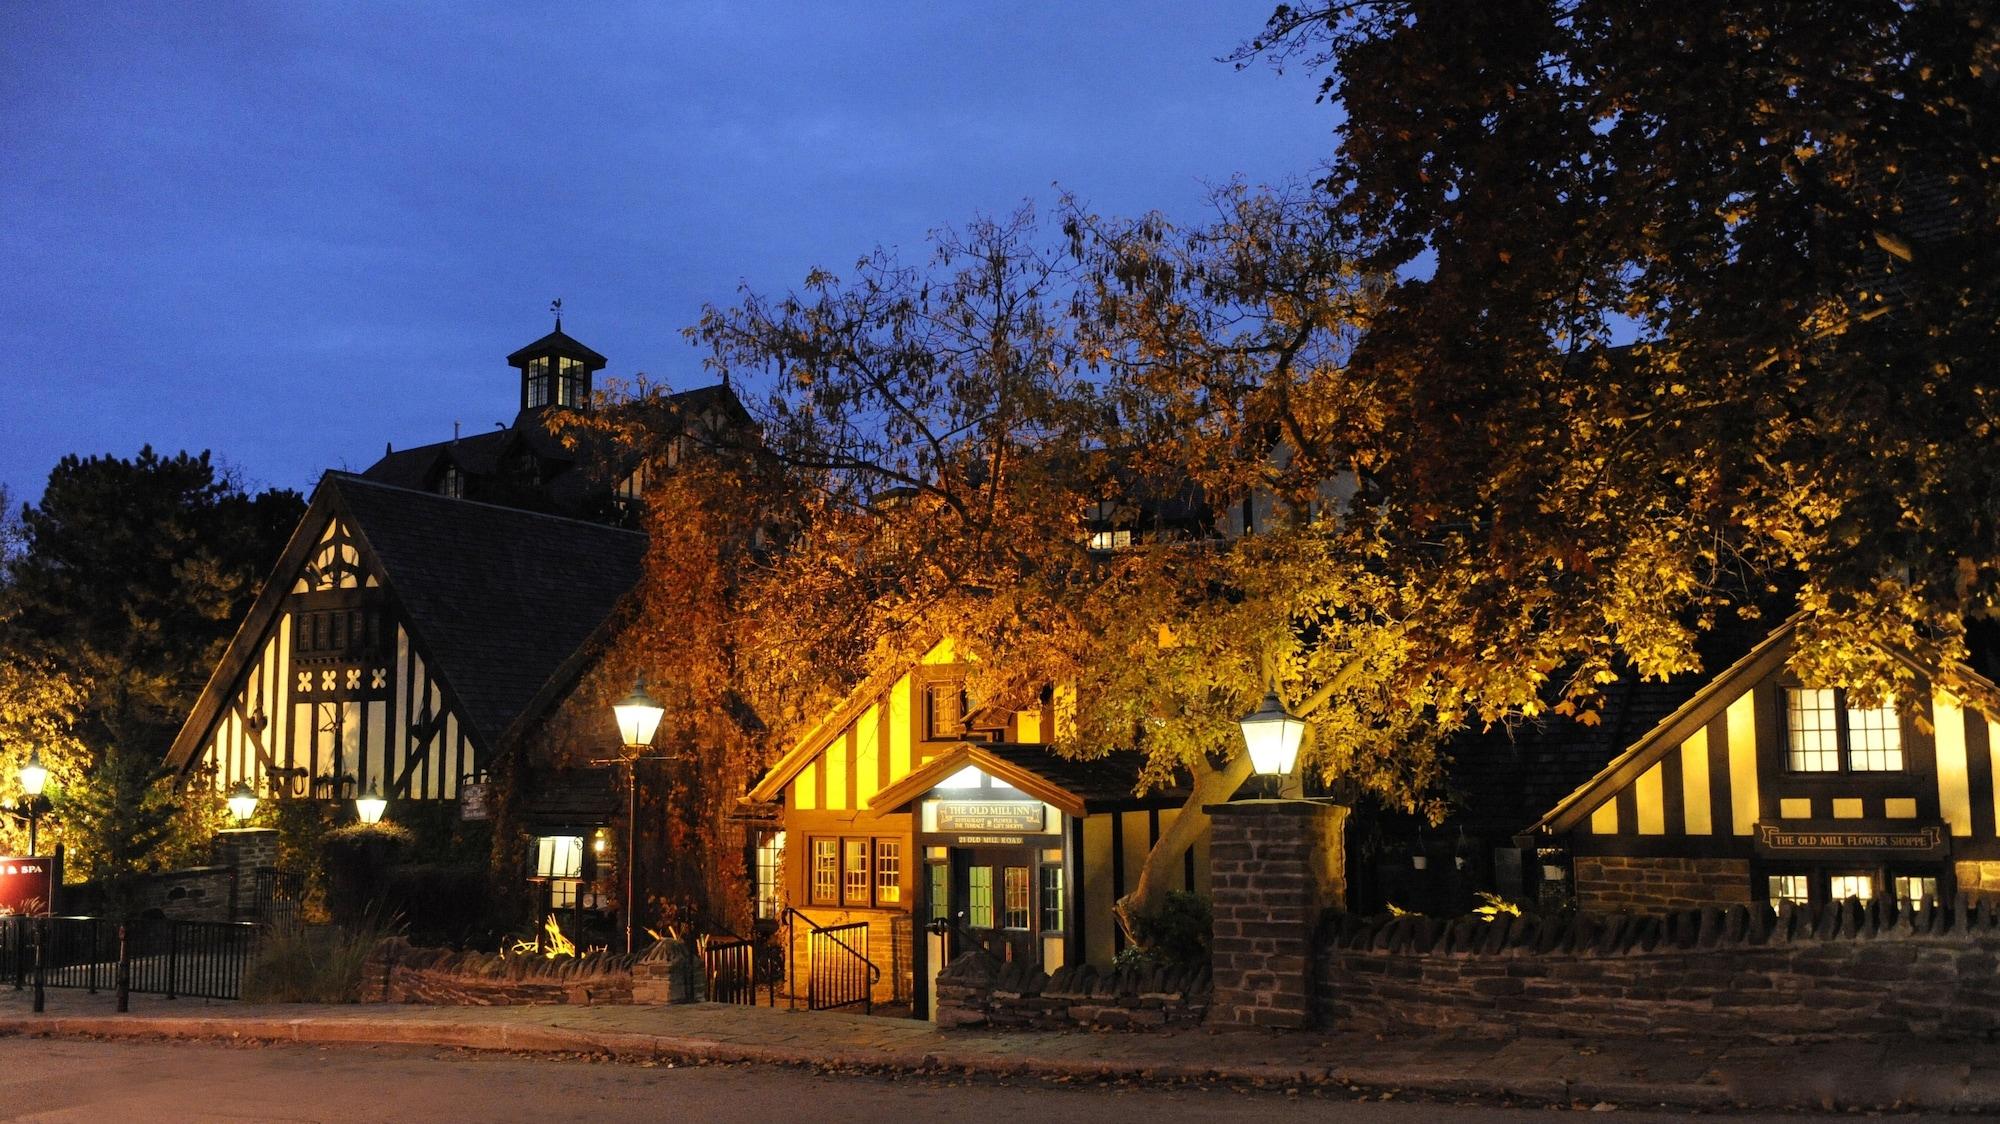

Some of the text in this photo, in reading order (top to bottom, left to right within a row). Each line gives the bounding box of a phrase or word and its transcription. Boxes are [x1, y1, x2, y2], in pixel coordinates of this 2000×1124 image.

[949, 806, 1030, 815] THE OLD MILL INN
[1776, 836, 1927, 847] THE OLD MILL FLOWER SHOPPE
[21, 865, 42, 874] SPA
